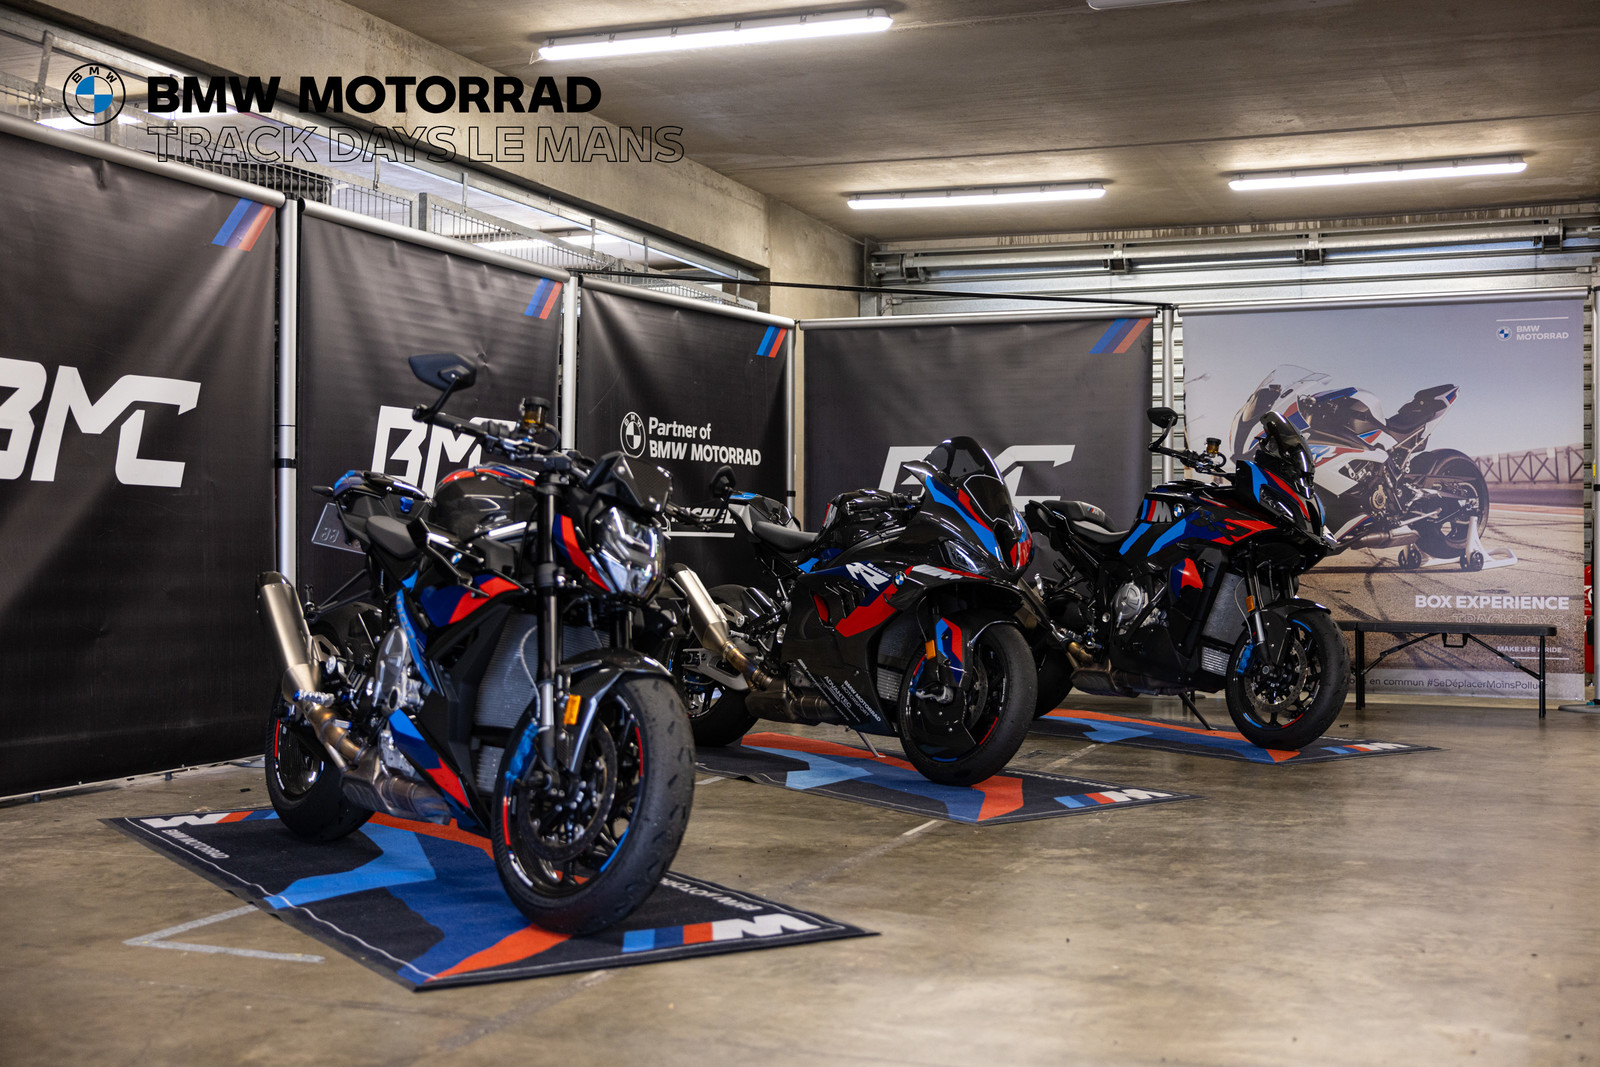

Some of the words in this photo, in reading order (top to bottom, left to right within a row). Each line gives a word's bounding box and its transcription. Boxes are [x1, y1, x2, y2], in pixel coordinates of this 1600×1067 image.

[1516, 324, 1540, 333] BMW
[1516, 332, 1569, 341] MOTORRAD
[648, 416, 697, 439] Partner
[699, 422, 712, 440] of
[649, 440, 687, 460] BMW
[690, 443, 762, 466] MOTORRAD
[1415, 594, 1452, 609] BOX
[1456, 595, 1570, 610] EXPERIENCE
[1497, 645, 1520, 653] MAKE
[1544, 646, 1563, 654] RIDE
[1383, 678, 1425, 687] commun
[1426, 678, 1548, 690] #SeDéplacerMoinsPollu
[854, 693, 882, 722] MOTORRAD
